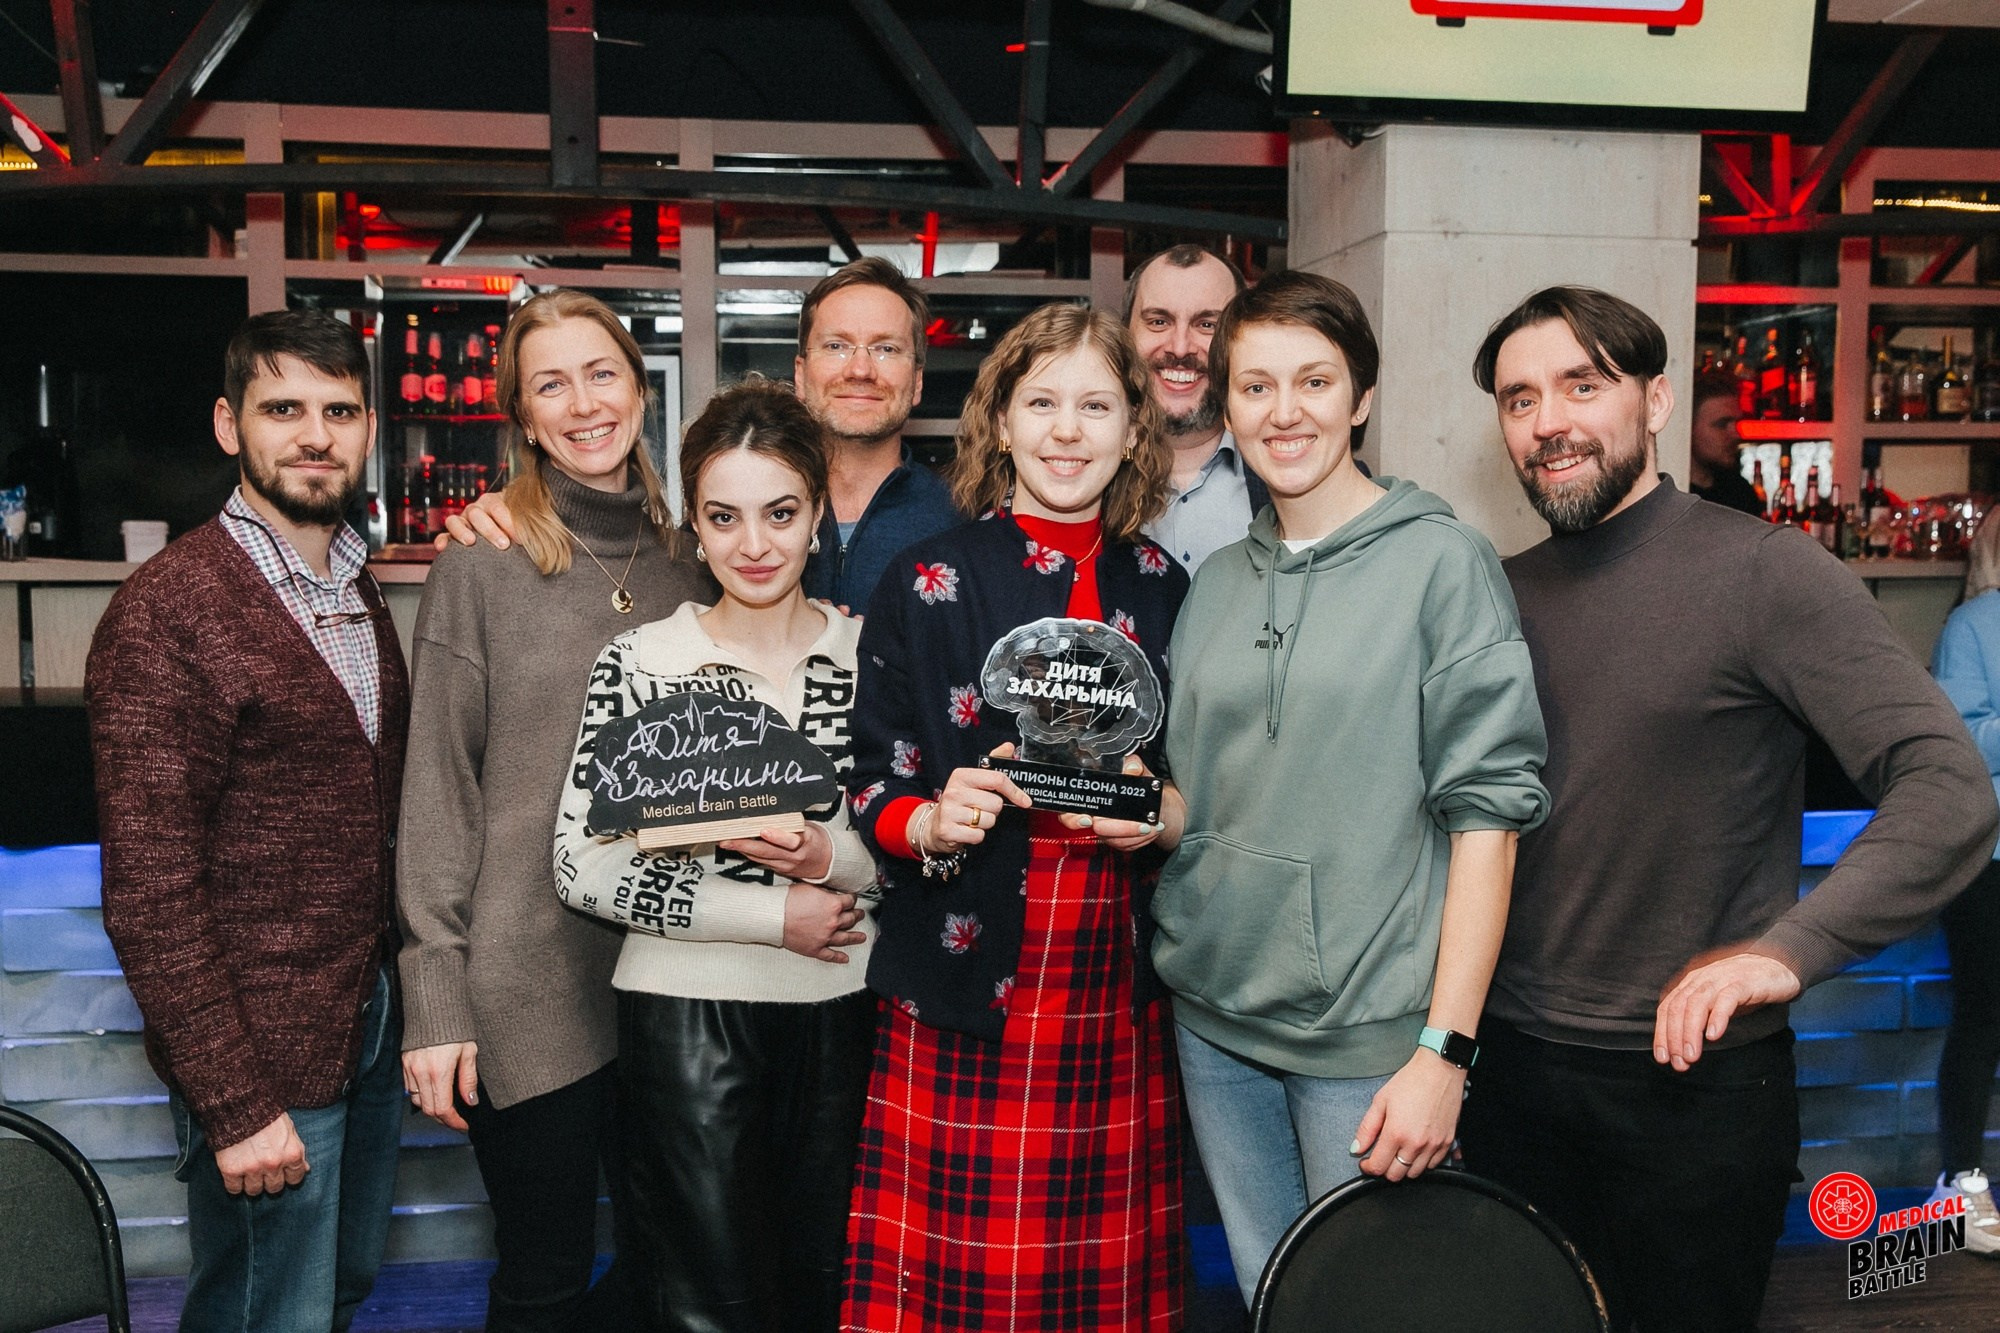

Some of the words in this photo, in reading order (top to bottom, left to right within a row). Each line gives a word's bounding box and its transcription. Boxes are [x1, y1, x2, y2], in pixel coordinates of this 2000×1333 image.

[1045, 661, 1102, 684] ДИТЯ
[1006, 677, 1137, 708] ЗАХАРЬИНА
[1022, 787, 1057, 799] MEDICAL
[1058, 791, 1084, 802] BRAIN
[1085, 795, 1113, 806] BATTLE
[1069, 778, 1118, 794] СЕЗОНА
[1120, 786, 1146, 797] 2022
[643, 802, 695, 819] Medical
[701, 799, 735, 813] Brain
[740, 794, 778, 809] Battle
[613, 875, 636, 910] YOU
